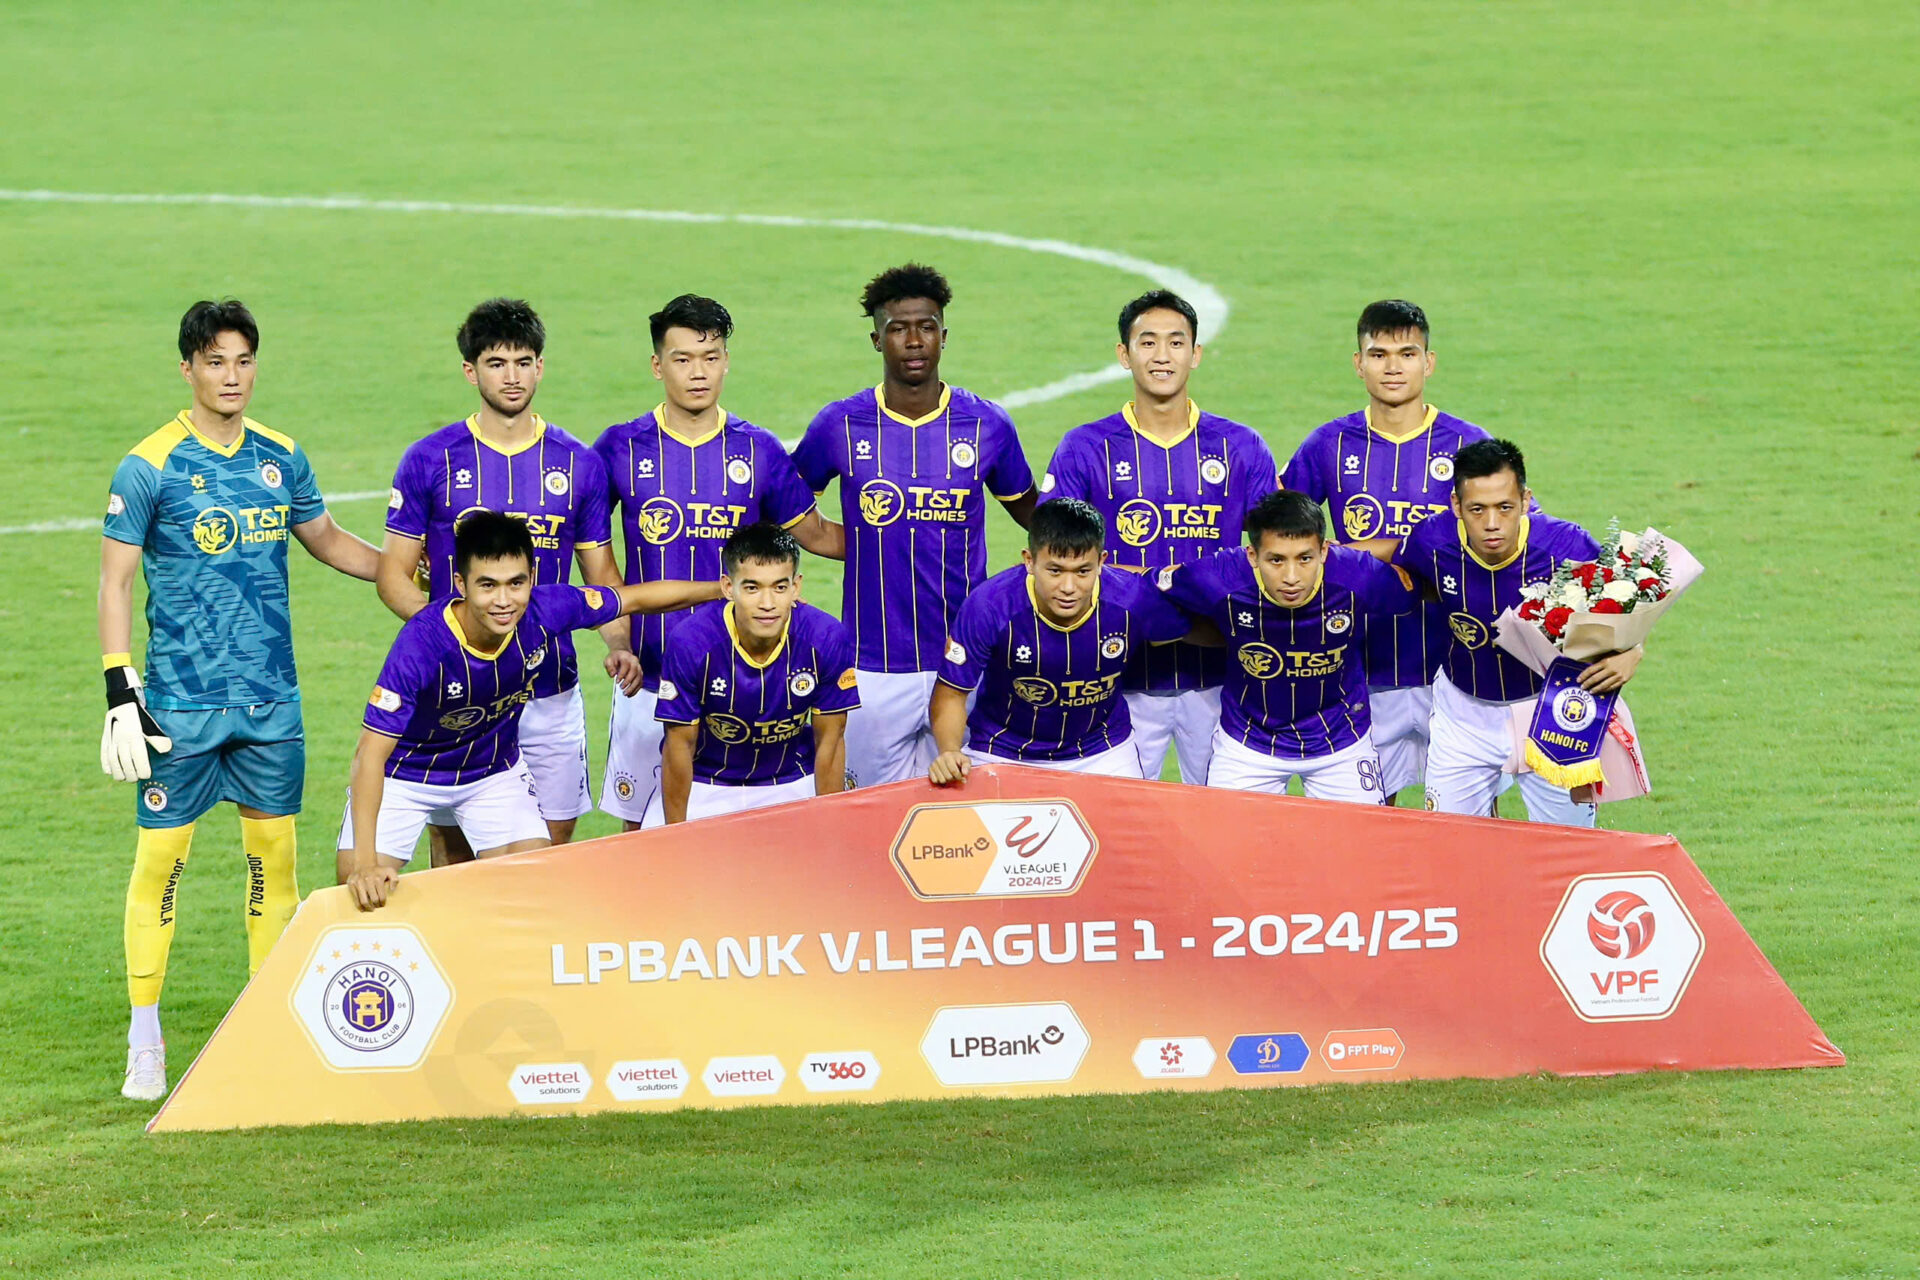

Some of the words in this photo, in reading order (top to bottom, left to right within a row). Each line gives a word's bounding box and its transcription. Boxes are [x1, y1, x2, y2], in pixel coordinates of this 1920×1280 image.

[908, 486, 971, 509] T&T
[238, 505, 289, 530] T&T
[687, 503, 747, 527] T&T
[906, 508, 967, 522] HOMES
[1163, 503, 1222, 526] T&T
[685, 526, 734, 539] HOME
[1163, 526, 1221, 539] HOMES
[531, 536, 560, 549] MES
[1286, 643, 1348, 668] T&T
[1061, 671, 1122, 698] T&T
[1563, 689, 1592, 703] HANOI
[752, 727, 801, 744] HOME
[1541, 729, 1574, 748] HANOI
[1575, 740, 1588, 752] FC
[912, 843, 974, 860] LPBank
[1003, 863, 1060, 875] V.LEAGUE
[1063, 862, 1067, 873] 1
[247, 853, 265, 917] JOGARBOLA
[1008, 875, 1063, 887] 2024/25
[160, 858, 184, 927] JOGARBOLA
[551, 934, 807, 984] LPBANK
[819, 920, 1118, 974] V.LEAGUE
[1133, 918, 1165, 961] 1
[1211, 906, 1460, 958] 2024/25
[337, 966, 398, 989] HANOI
[1590, 969, 1659, 996] VPF
[338, 1025, 379, 1044] FOOTBALL
[382, 1023, 400, 1040] CLUB
[950, 1035, 1041, 1058] LPBank
[1347, 1045, 1369, 1056] FPT
[1372, 1044, 1396, 1057] Play
[520, 1071, 581, 1085] viettel
[618, 1067, 678, 1082] viettel
[714, 1069, 774, 1083] viettel
[539, 1087, 581, 1095] solutions
[636, 1083, 678, 1092] solutions
